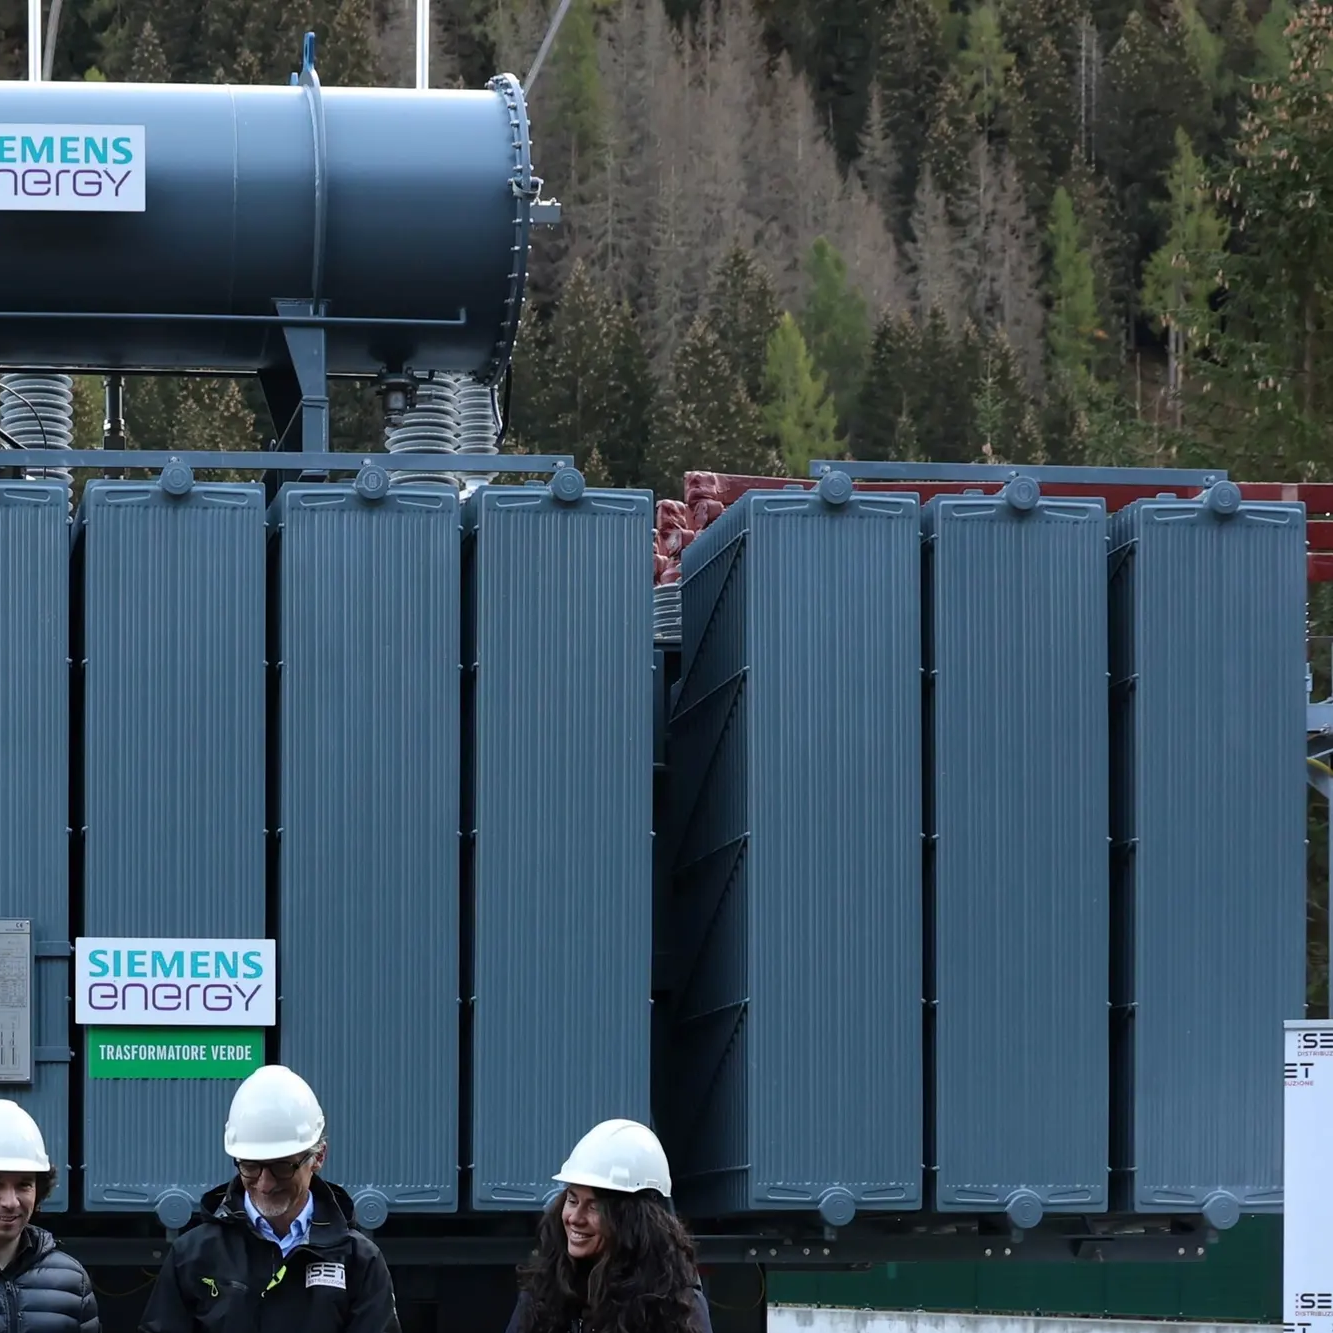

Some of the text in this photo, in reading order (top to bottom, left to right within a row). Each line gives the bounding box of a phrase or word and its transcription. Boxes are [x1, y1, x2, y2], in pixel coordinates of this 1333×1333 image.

[88, 949, 264, 979] SIEMENS
[99, 1045, 252, 1061] TRASFORMATORE VERDE
